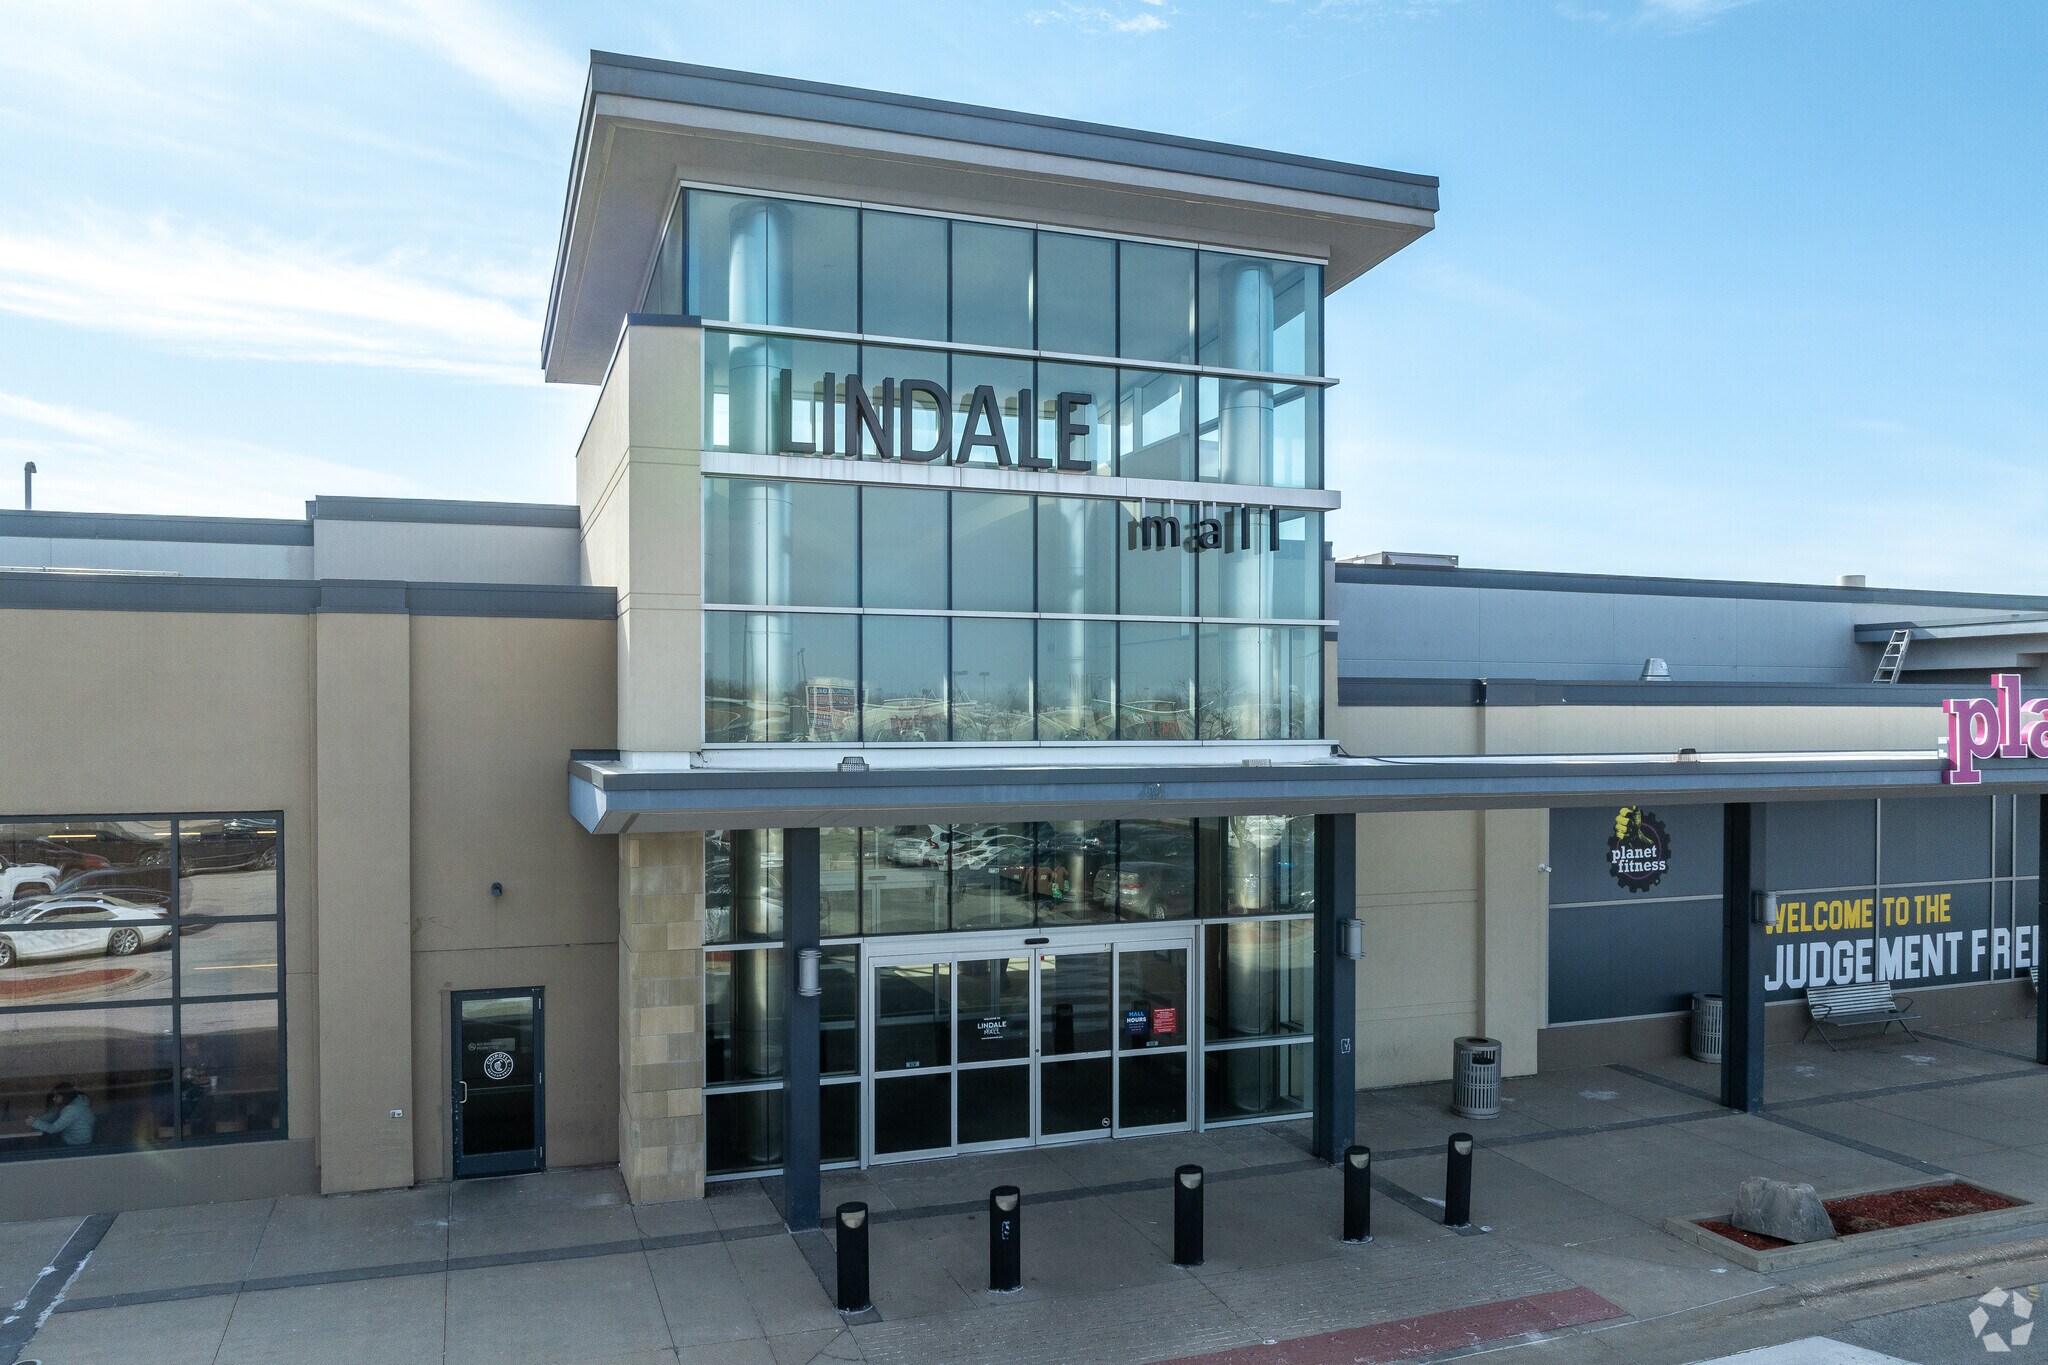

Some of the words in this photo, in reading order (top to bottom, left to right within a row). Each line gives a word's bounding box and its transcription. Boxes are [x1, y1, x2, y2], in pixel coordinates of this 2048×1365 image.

[779, 368, 1093, 472] LINDALE
[1141, 505, 1280, 552] mall
[1611, 845, 1657, 864] planet
[1618, 859, 1667, 873] fitness
[1765, 898, 1874, 934] WELCOME
[1882, 896, 1910, 926] TO
[1914, 893, 1951, 924] THE
[1764, 931, 1963, 991] JUDGEMENT
[977, 1021, 1007, 1029] LINDALE
[486, 1053, 511, 1065] CHIPOTLE
